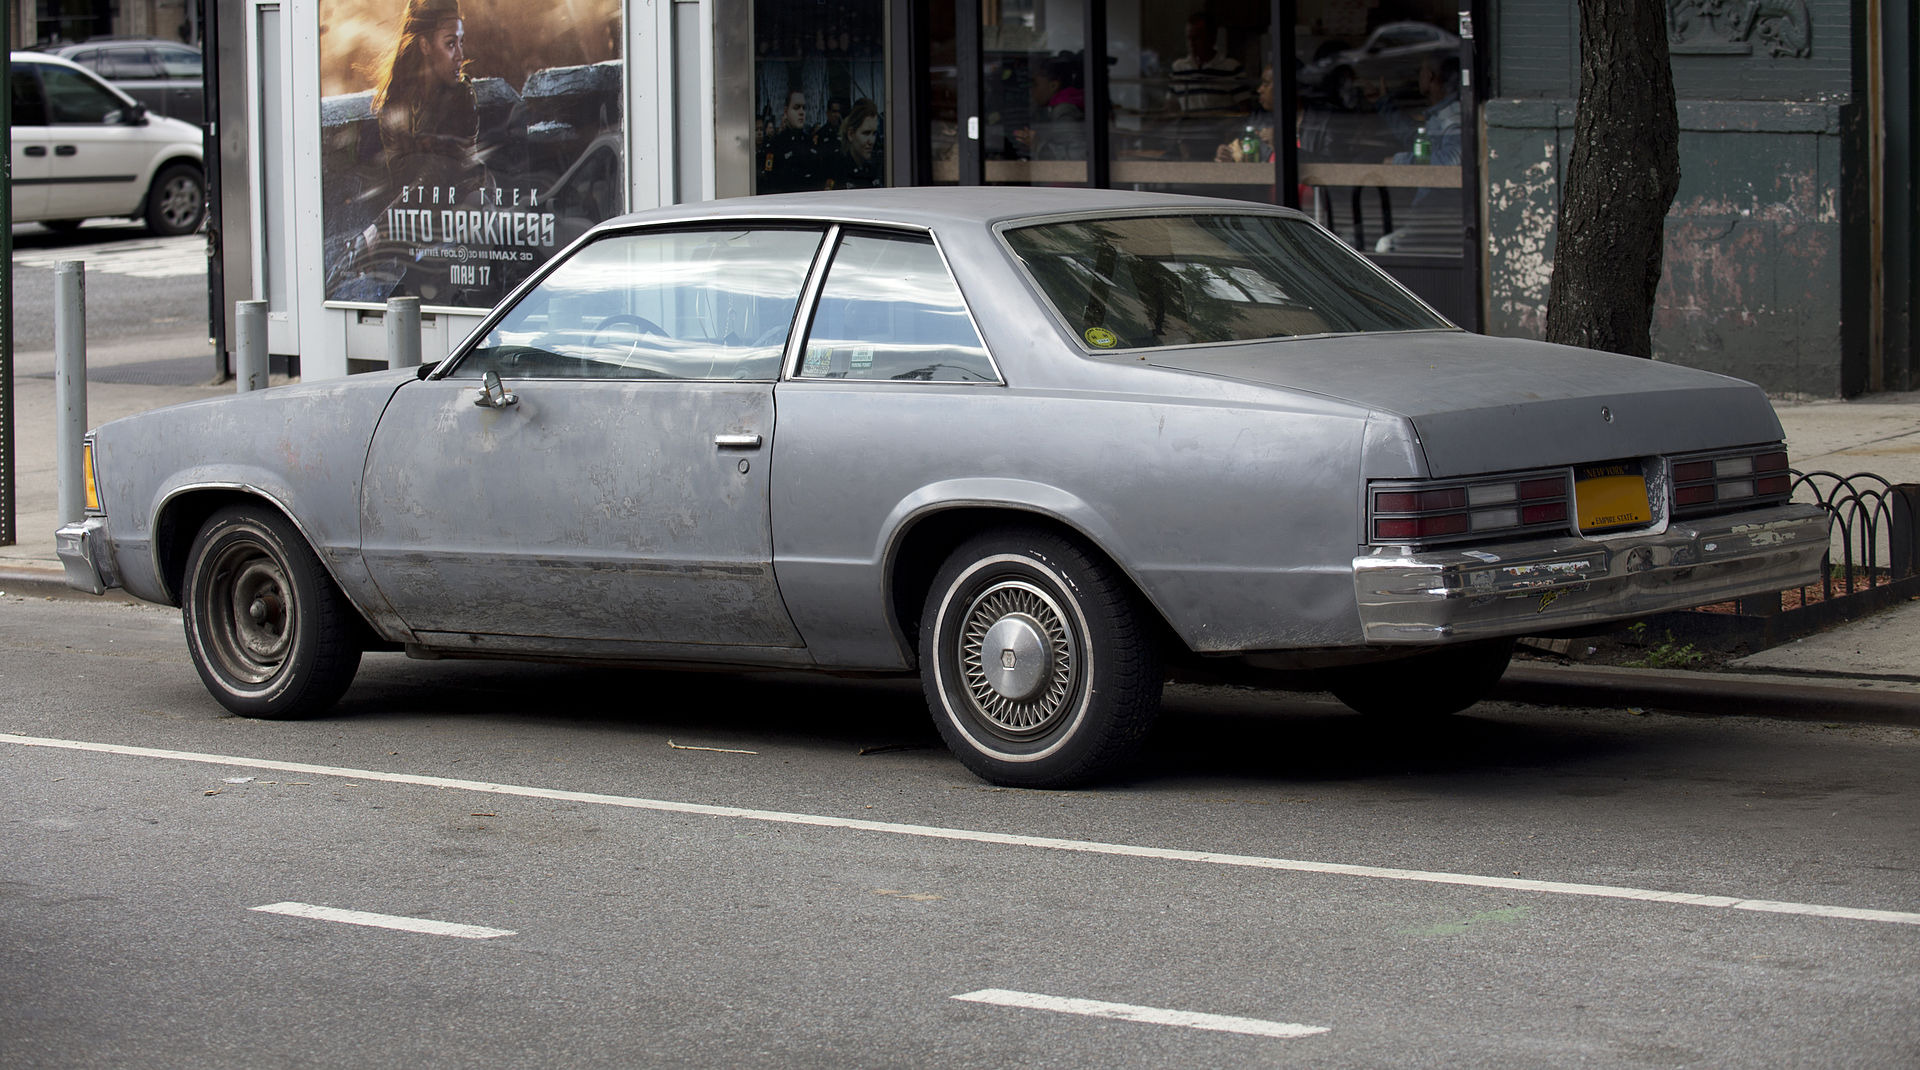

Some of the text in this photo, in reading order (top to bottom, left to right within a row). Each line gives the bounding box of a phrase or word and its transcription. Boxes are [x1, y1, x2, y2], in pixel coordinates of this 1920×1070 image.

[402, 186, 538, 207] STAR TREK
[388, 208, 555, 247] INTO DARKNESS
[489, 251, 517, 261] IMAX
[520, 252, 533, 261] 3D
[450, 265, 491, 286] MAY 17
[1584, 465, 1624, 478] NEW YORK
[1595, 513, 1634, 525] EMPIRE STATE
